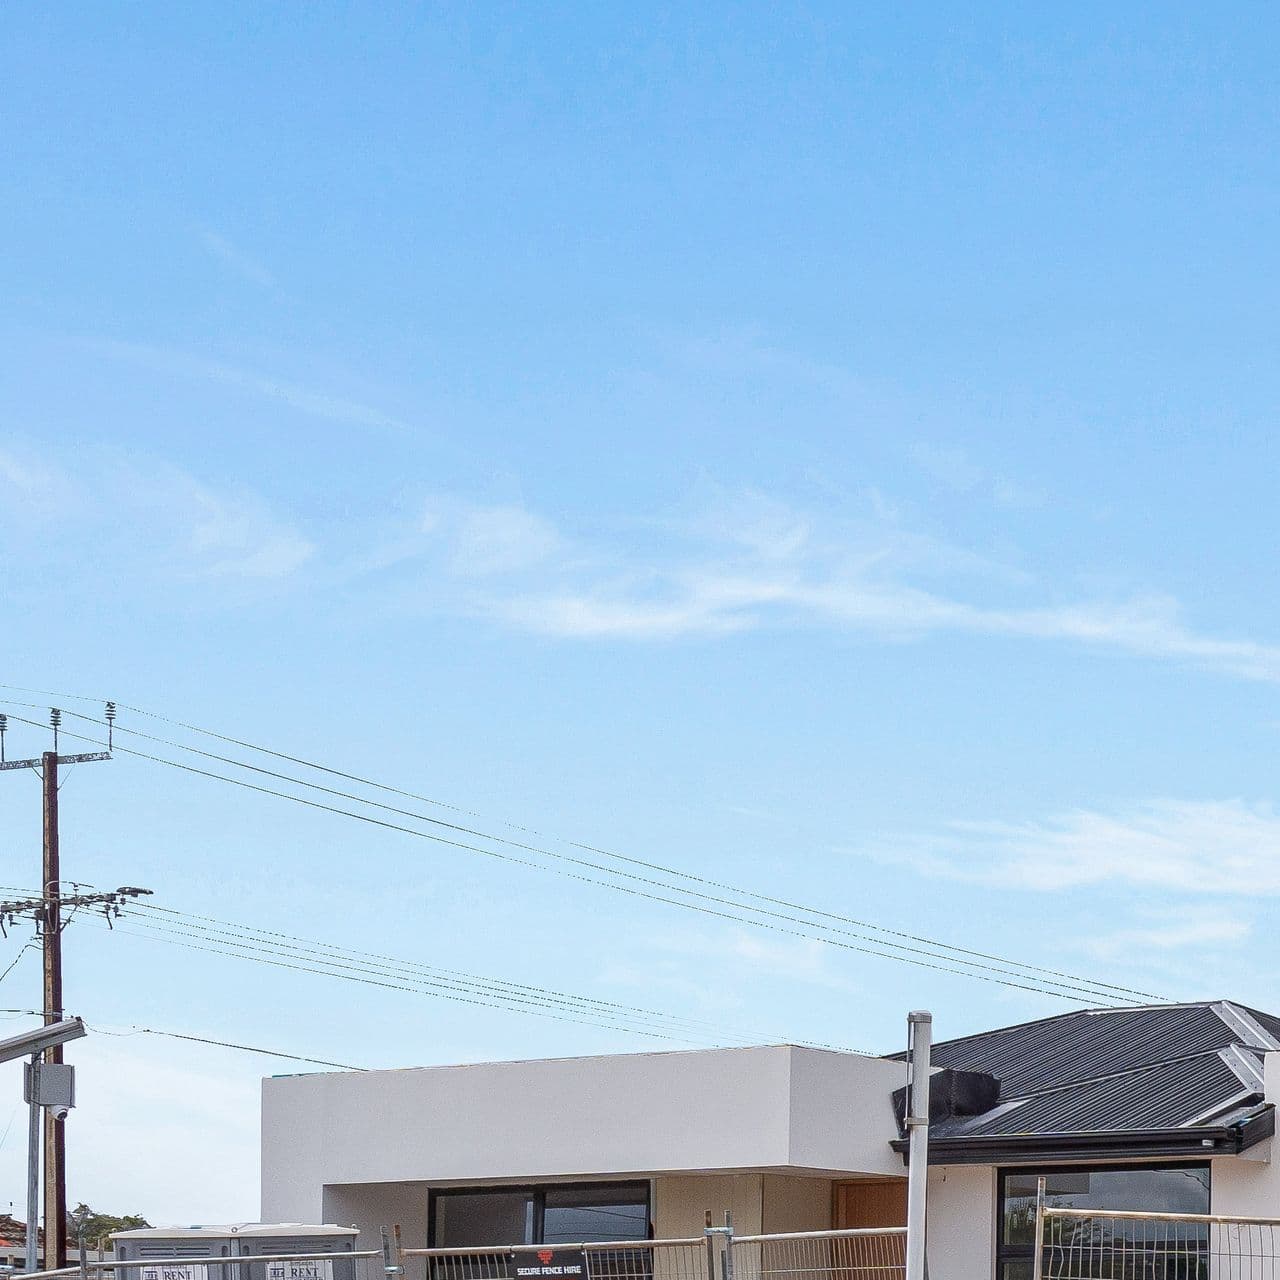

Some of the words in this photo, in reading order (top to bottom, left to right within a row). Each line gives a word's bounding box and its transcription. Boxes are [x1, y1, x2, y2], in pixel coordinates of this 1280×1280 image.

[164, 1270, 193, 1280] RENT
[291, 1267, 319, 1277] RENT
[517, 1267, 541, 1275] SECURE
[541, 1266, 563, 1275] FENCE
[564, 1265, 582, 1274] HIRE
